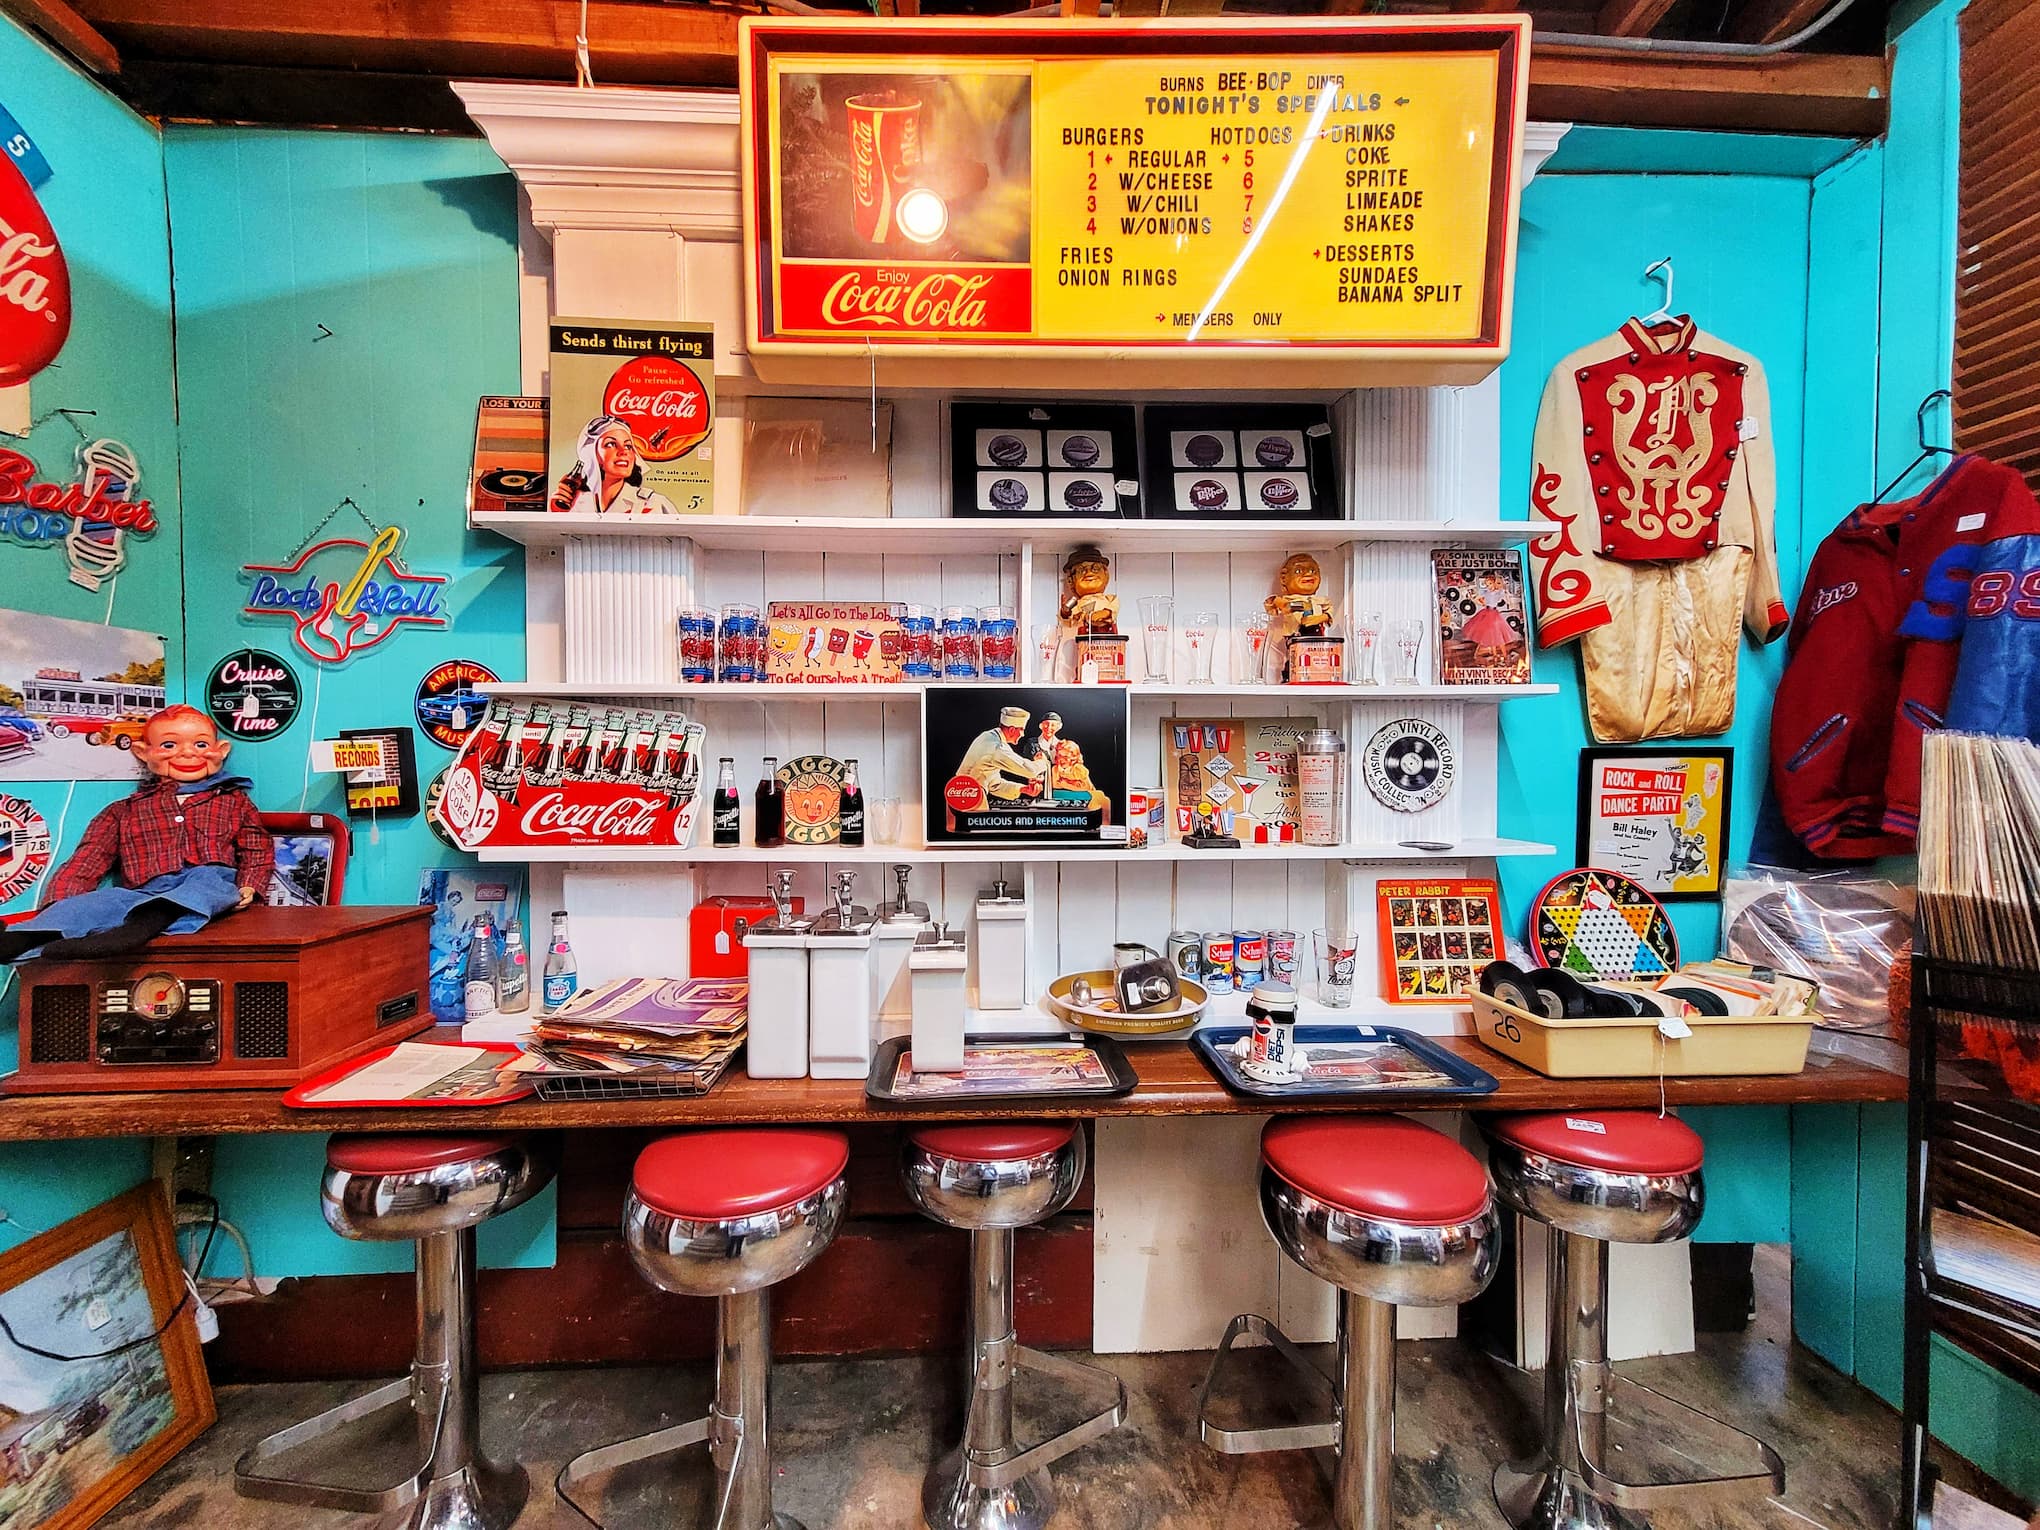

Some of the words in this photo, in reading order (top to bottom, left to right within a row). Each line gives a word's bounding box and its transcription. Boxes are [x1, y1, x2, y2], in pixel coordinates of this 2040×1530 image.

[1160, 77, 1205, 91] BURNS
[1145, 95, 1260, 115] TONIGHT'S
[1277, 93, 1382, 114] SPEIALS
[1062, 127, 1145, 146] BURGERS
[1210, 125, 1293, 145] HOTDOGS
[1331, 123, 1396, 144] DRINKS
[1087, 151, 1097, 168] 1
[1128, 150, 1208, 169] REGULAR
[1244, 150, 1255, 168] 5
[1346, 146, 1391, 165] COKE
[1088, 172, 1098, 190] 2
[1119, 171, 1213, 191] W/CHEESE
[1243, 172, 1254, 190] 6
[1345, 169, 1409, 189] SPRITE
[1087, 194, 1097, 213] 3
[1127, 194, 1199, 213] W/CHILI
[1243, 194, 1254, 212] 7
[1346, 191, 1423, 210] LIMEADE
[1086, 217, 1097, 235] 4
[1120, 216, 1212, 235] W/ONIONS
[1242, 216, 1253, 235] 8
[1343, 214, 1415, 233] SHAKES
[1060, 246, 1114, 265] FRIES
[1326, 244, 1415, 262] DESSERTS
[876, 269, 910, 284] Enjoy
[1058, 269, 1110, 287] ONION
[1122, 269, 1178, 287] RINGS
[1339, 266, 1418, 285] SUNDAES
[821, 270, 993, 328] Coca-Cola
[1337, 285, 1405, 303] BANANA
[1414, 284, 1463, 303] SPLIT
[1253, 311, 1283, 327] ONLY
[562, 331, 606, 348] Sends
[612, 334, 652, 350] thirst
[659, 336, 703, 355] flying
[628, 375, 642, 385] Go
[644, 376, 685, 386] refreshed
[483, 399, 510, 408] LOSE
[513, 400, 542, 409] YOUR
[610, 388, 701, 419] Coca-Cola
[1437, 560, 1458, 568] ARE
[1460, 560, 1485, 568] JUST
[250, 575, 322, 609] Rock
[380, 583, 440, 615] Roll
[772, 604, 797, 619] Let's
[799, 605, 815, 619] All
[816, 607, 832, 620] Go
[834, 607, 848, 620] To
[850, 606, 868, 620] The
[221, 660, 287, 685] Cruise
[768, 673, 784, 684] To
[785, 673, 805, 684] Get
[807, 673, 859, 684] Ourselves
[1466, 669, 1491, 678] VINYL
[231, 709, 280, 732] Time
[435, 726, 471, 745] MUS
[1175, 725, 1231, 750] TIKI
[334, 750, 380, 768] RECORDS
[1254, 752, 1271, 762] 2
[1274, 752, 1298, 761] for
[1398, 722, 1431, 739] VINYL
[1431, 733, 1453, 779] RECORD
[777, 757, 843, 785] PIGGL
[1266, 764, 1298, 776] Nite
[1370, 747, 1383, 777] MUSIC
[1278, 780, 1292, 788] in
[1605, 770, 1636, 788] ROCK
[1638, 780, 1652, 789] and
[1654, 774, 1683, 791] ROLL
[1275, 790, 1296, 799] the
[450, 788, 469, 821] Coke
[521, 792, 668, 836] Coca-Cola
[1603, 797, 1638, 814] DANCE
[1643, 796, 1679, 812] PARTY
[475, 808, 496, 828] 12
[678, 814, 690, 829] 12
[968, 816, 1013, 826] DELICIOUS
[1015, 816, 1034, 826] AND
[1035, 816, 1088, 826] REFRESHING
[786, 819, 840, 841] IGGL
[1612, 822, 1628, 833] Bill
[1631, 825, 1658, 838] Haley
[1379, 886, 1411, 897] PETER
[1415, 886, 1451, 896] RABBIT
[1492, 1008, 1521, 1043] 26
[1267, 1038, 1276, 1061] DIET
[1275, 1028, 1285, 1064] PEPSI
